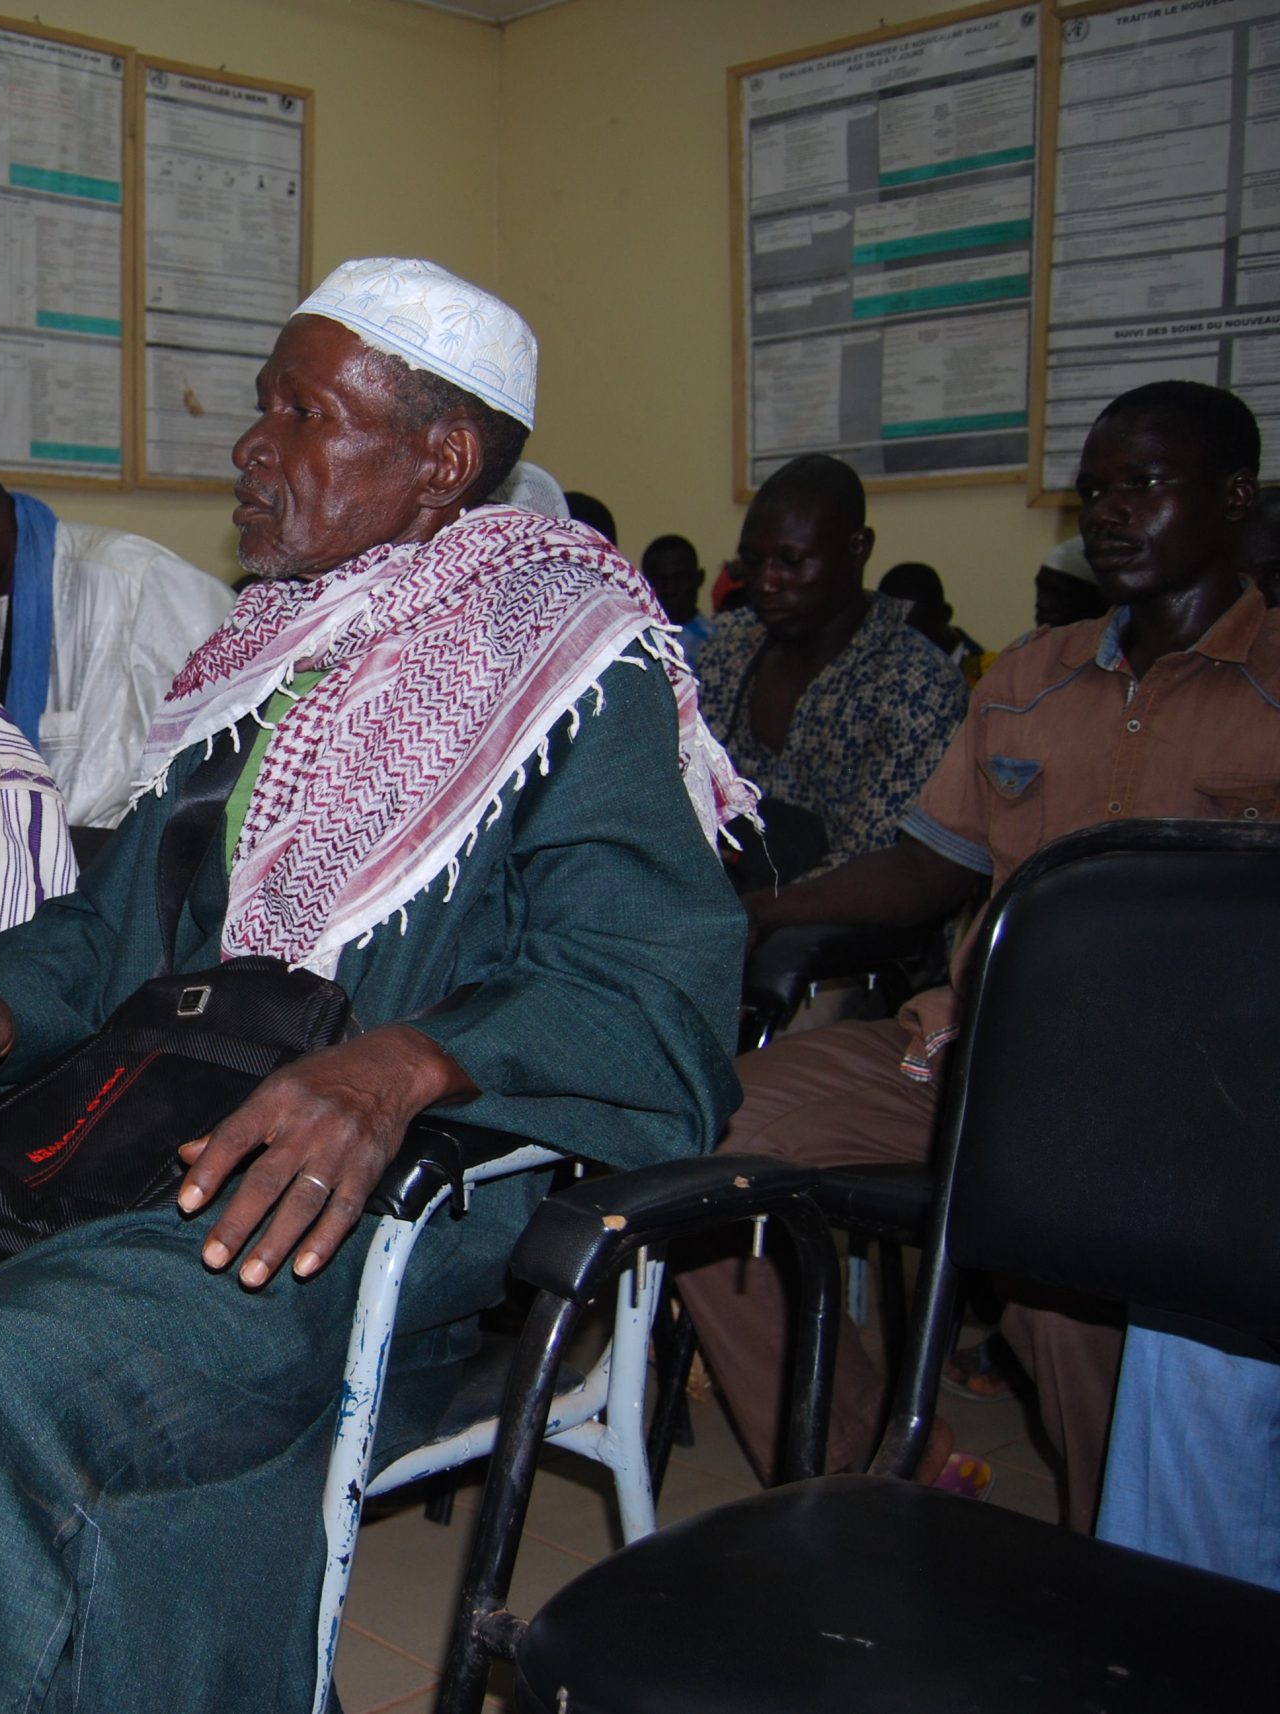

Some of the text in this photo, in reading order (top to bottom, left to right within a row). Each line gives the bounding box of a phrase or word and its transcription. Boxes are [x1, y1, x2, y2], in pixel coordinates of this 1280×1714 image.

[1116, 9, 1160, 25] TRAITER
[1164, 6, 1178, 15] LE
[1114, 327, 1145, 340] SUIVI
[1146, 326, 1168, 337] DES
[1171, 322, 1204, 335] SOINS
[1206, 319, 1223, 331] DU
